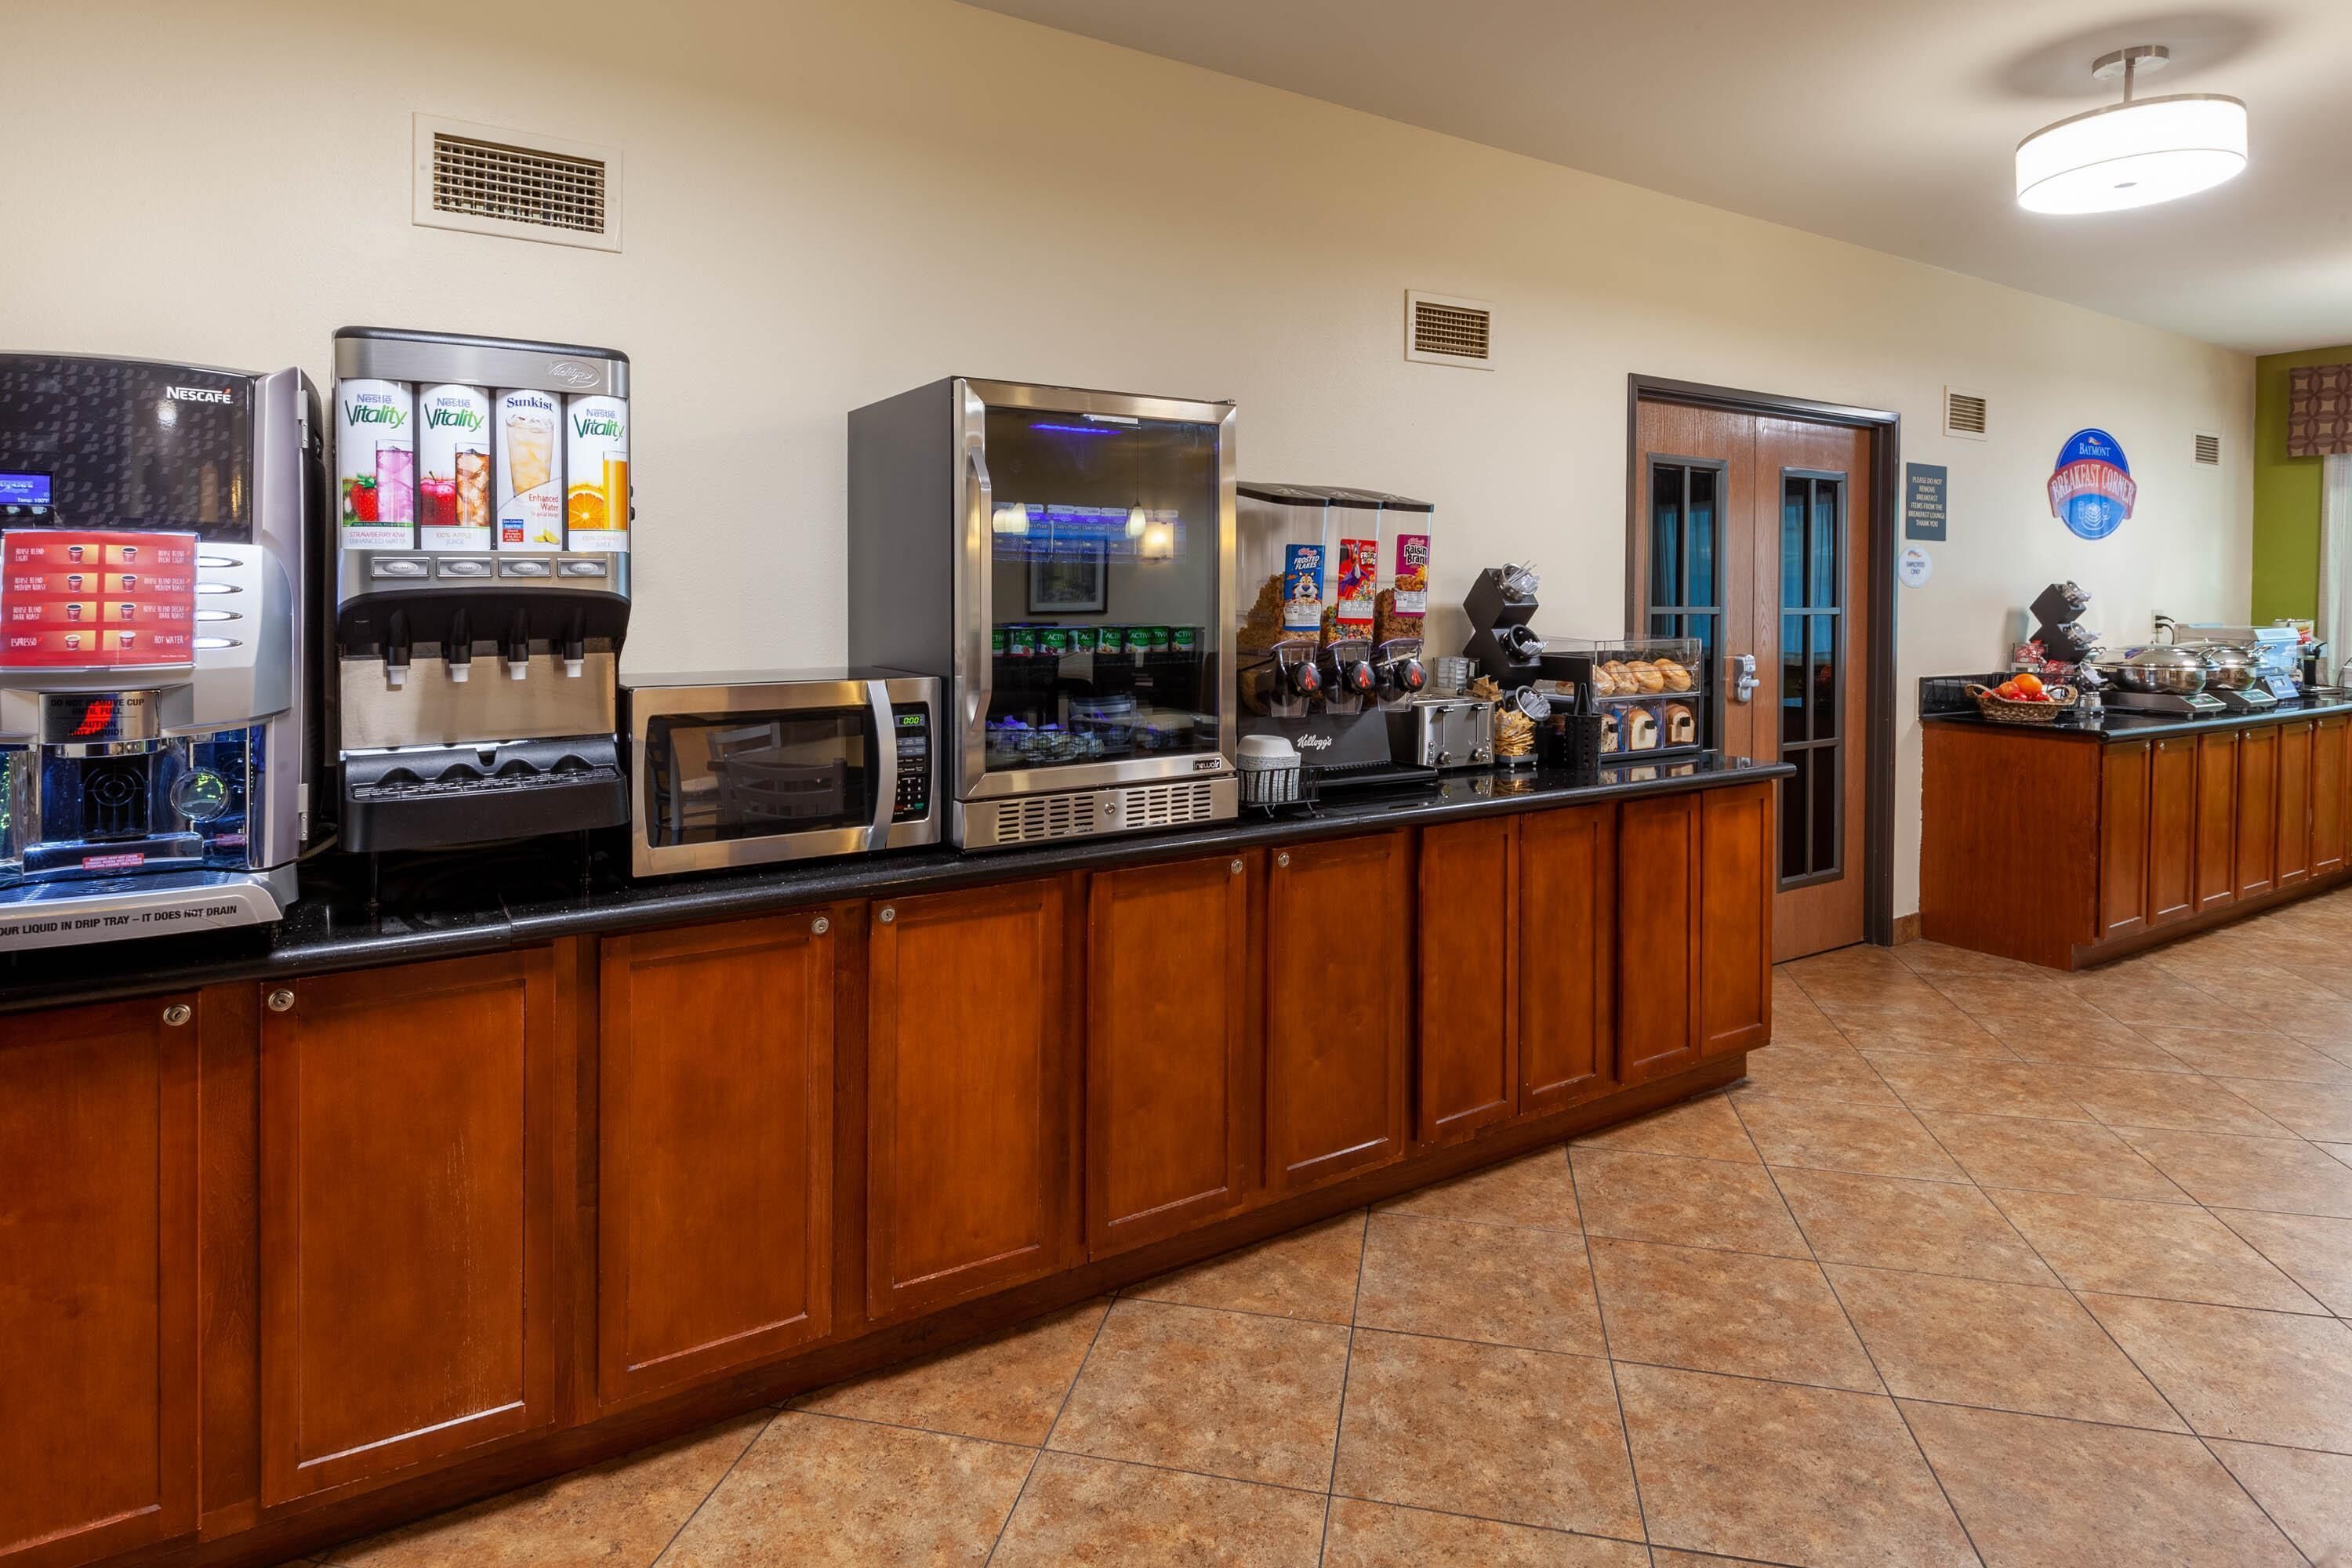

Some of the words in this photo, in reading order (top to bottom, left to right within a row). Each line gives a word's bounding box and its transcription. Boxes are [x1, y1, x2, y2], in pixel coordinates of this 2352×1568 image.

[166, 386, 232, 404] NESCAFÉ
[357, 394, 392, 404] Nestlé
[437, 397, 470, 408] Nestlé
[506, 397, 553, 412] Sunkist
[345, 399, 408, 429] Vitality
[424, 403, 485, 432] Vitality
[573, 413, 625, 441] Vitality
[2051, 464, 2101, 503] BREAKFAST
[2102, 466, 2134, 506] CORNER
[528, 493, 558, 503] Enhanced
[1404, 545, 1428, 556] Raisin
[1294, 555, 1320, 564] FROSTED
[1406, 554, 1425, 564] Bran
[1295, 561, 1317, 571] FLAKES
[11, 637, 37, 646] ESPRESSO
[165, 635, 183, 644] WATER
[1297, 734, 1333, 750] Kellogg's
[22, 922, 58, 935] LIQUID
[61, 921, 72, 931] IN
[75, 918, 100, 929] DRIP
[103, 916, 129, 926] TRAY
[142, 913, 151, 923] IT
[154, 911, 181, 921] DOES
[184, 909, 204, 918] NOT
[206, 906, 237, 916] DRAIN
